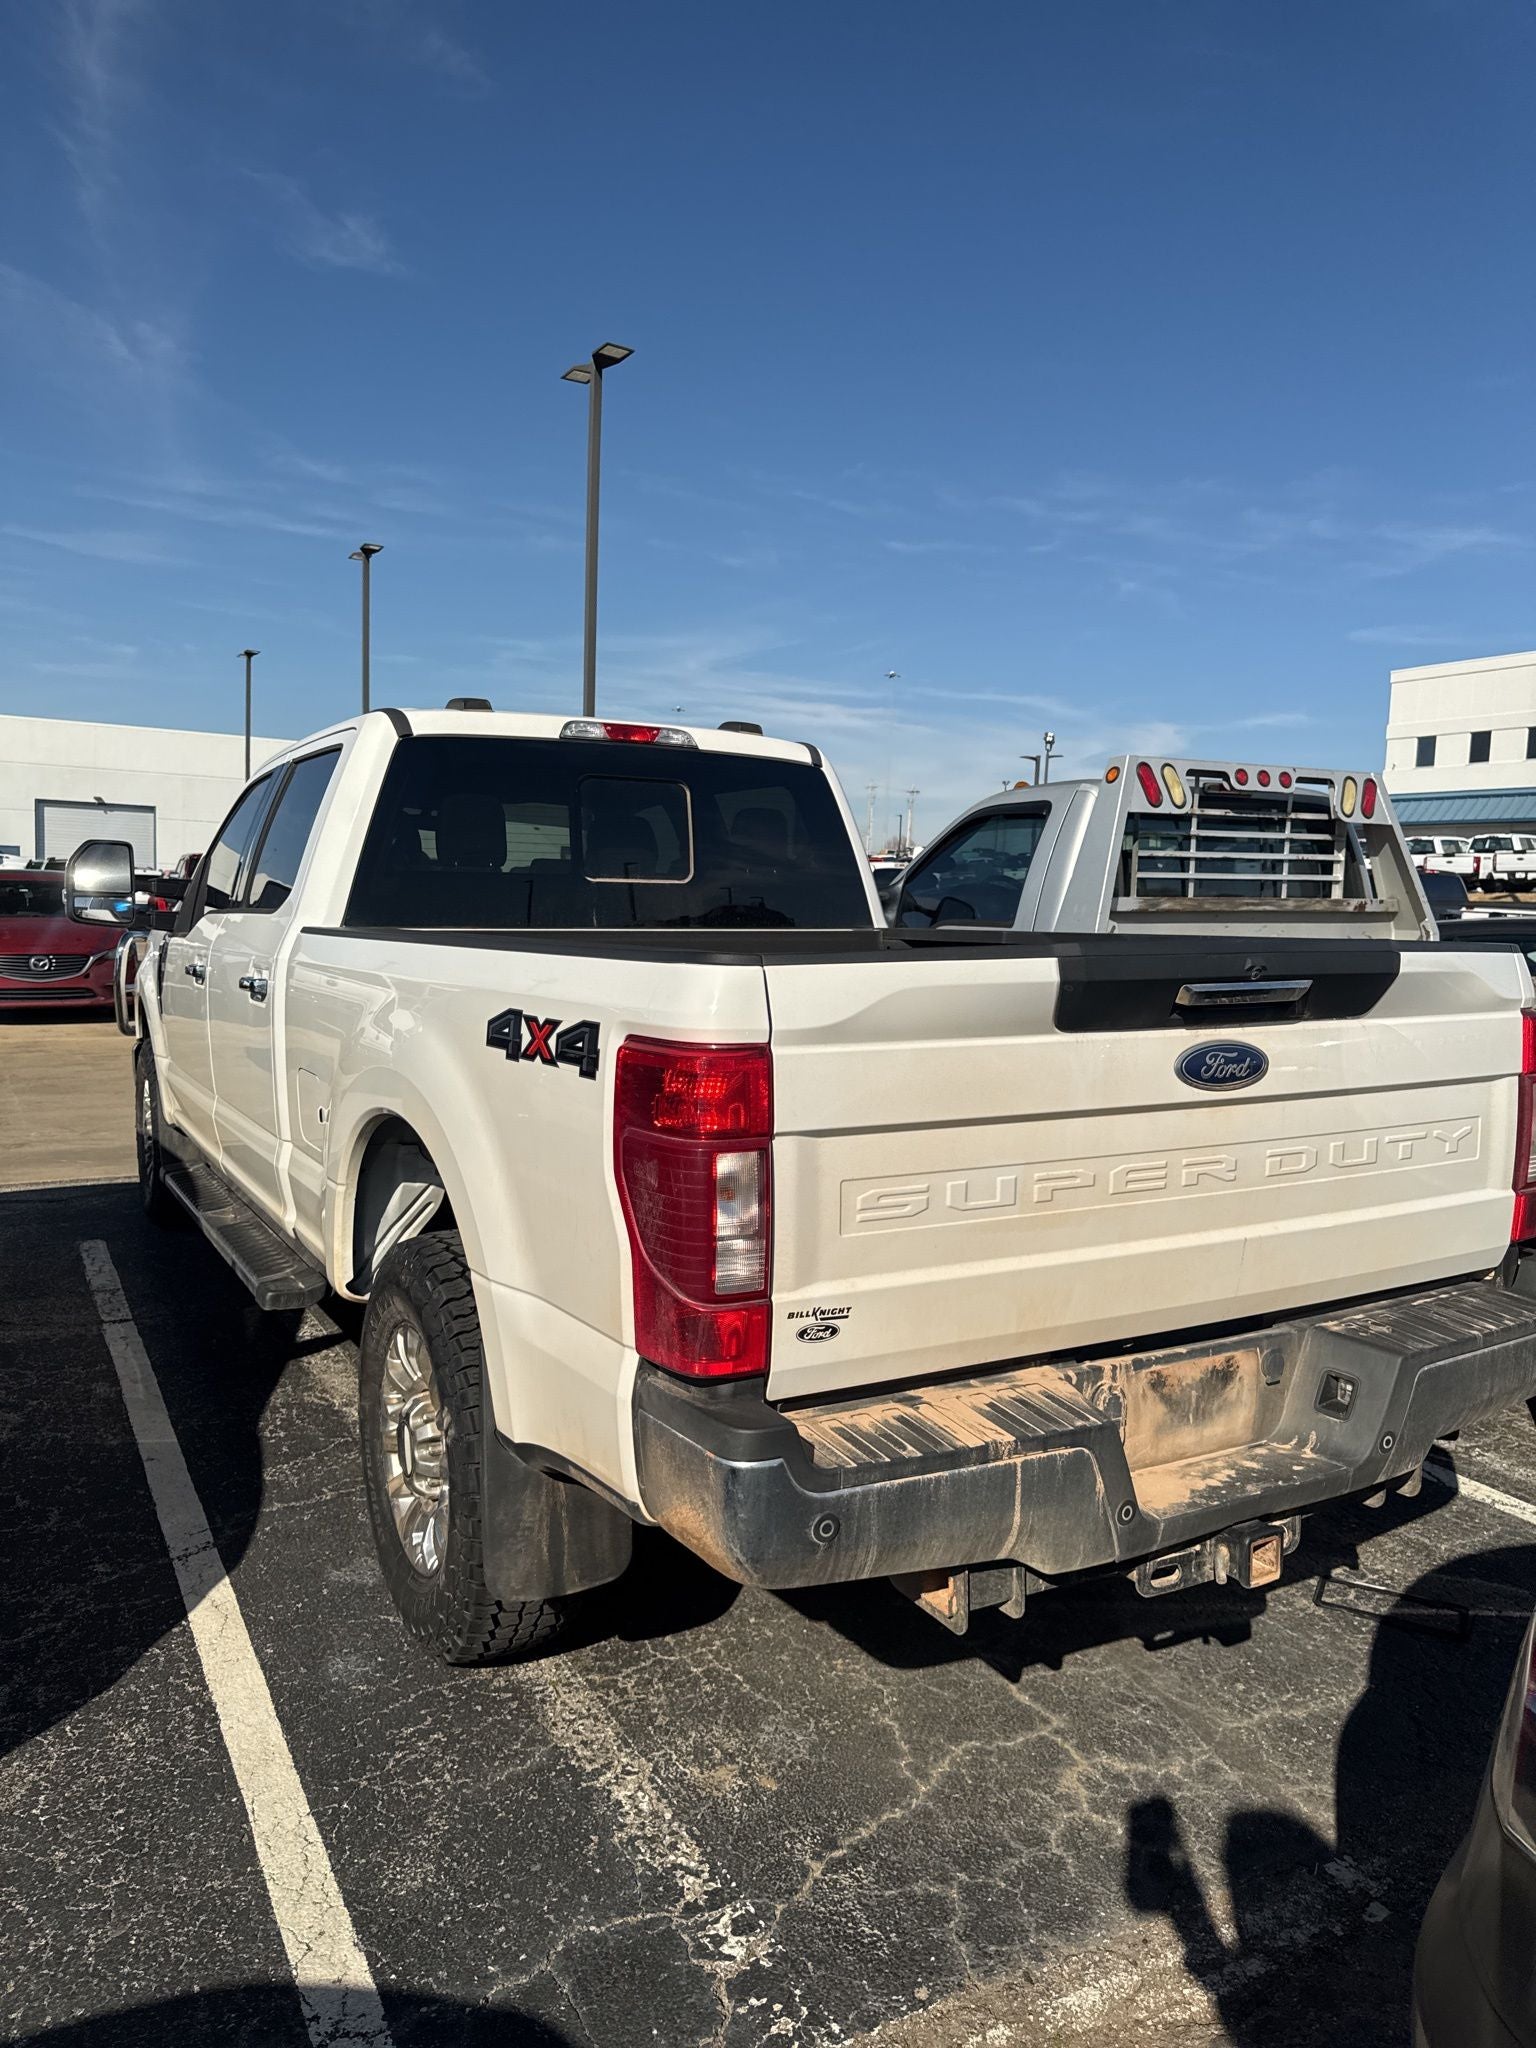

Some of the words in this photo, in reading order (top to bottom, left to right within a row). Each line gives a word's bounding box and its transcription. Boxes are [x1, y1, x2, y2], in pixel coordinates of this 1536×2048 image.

[1200, 1051, 1251, 1079] Ford
[856, 1153, 1238, 1223] SUPER
[1264, 1125, 1472, 1178] DUTY
[803, 1326, 833, 1340] Ford
